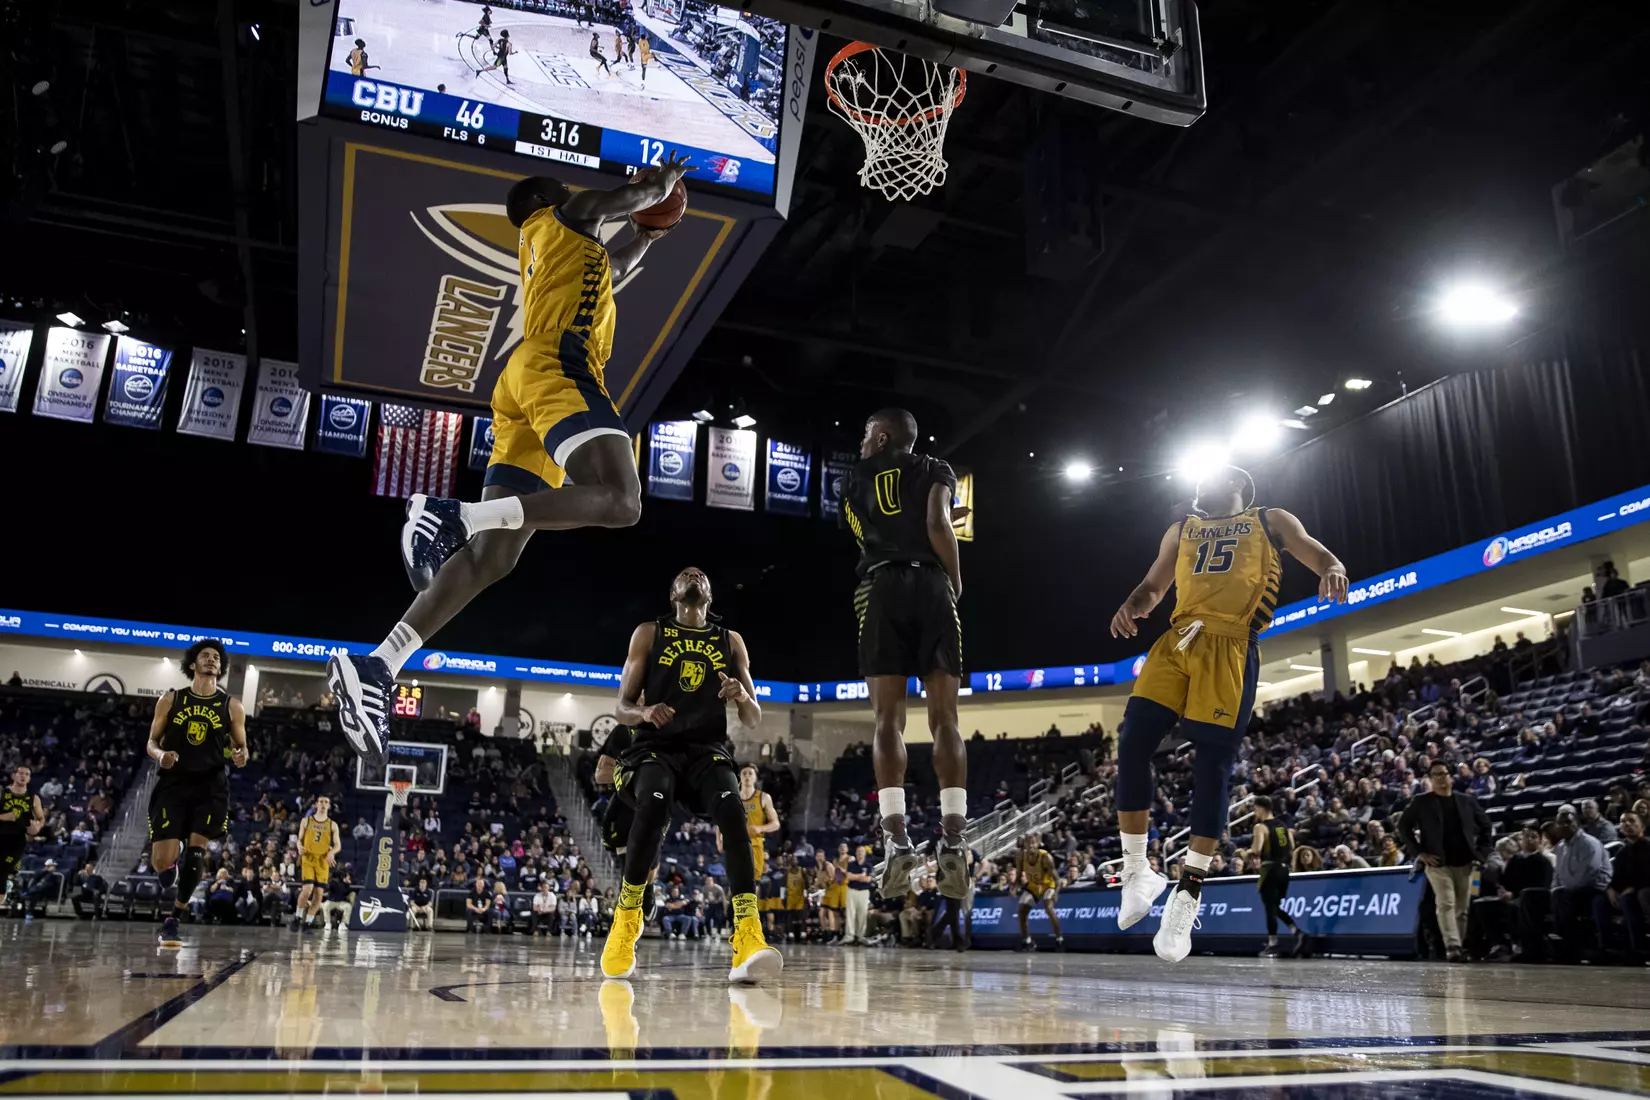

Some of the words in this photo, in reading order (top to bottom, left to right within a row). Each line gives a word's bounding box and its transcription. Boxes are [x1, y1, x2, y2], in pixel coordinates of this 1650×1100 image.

[790, 37, 806, 123] pepsi
[352, 79, 425, 117] CBU
[361, 110, 408, 129] BONUS
[456, 100, 484, 129] 46
[444, 127, 468, 141] FLS
[478, 134, 486, 145] 6
[540, 118, 580, 147] 3:16
[530, 145, 552, 158] 1ST
[559, 150, 590, 165] HALF
[640, 139, 665, 167] 12
[626, 165, 638, 176] FL
[420, 274, 508, 394] LANCERS
[48, 356, 100, 368] BASKETBALL
[129, 356, 156, 366] MEN'S
[203, 356, 234, 370] 2015
[116, 362, 166, 376] BASKETBALL
[204, 368, 228, 377] MEN'S
[192, 375, 240, 388] BASKETBALL
[271, 379, 296, 388] MEN'S
[48, 390, 81, 400] DIVISION
[258, 386, 307, 397] BASKETBALL
[41, 396, 92, 409] TOURNAMENT
[110, 400, 161, 414] TOURNAMENT
[110, 408, 156, 420] CHAMPIONS
[188, 408, 224, 418] DIVISION
[188, 418, 214, 426] SWEET
[260, 418, 291, 428] DIVISION
[253, 425, 302, 436] TOURNAMENT
[317, 430, 364, 442] CHAMPIONS
[649, 475, 691, 486] CHAMPIONS
[875, 468, 902, 516] 0
[1187, 522, 1254, 540] LANCERS
[1508, 522, 1572, 550] MAGNOLIA
[1192, 538, 1239, 576] 15
[1348, 572, 1418, 605] 800-2GET-AIR
[1274, 616, 1286, 626] GO
[1286, 609, 1306, 622] HOME
[1307, 606, 1318, 616] TO
[62, 622, 108, 634] COMFORT
[110, 627, 130, 636] YOU
[132, 629, 160, 639] WANT
[163, 632, 175, 640] TO
[177, 634, 190, 642] GO
[221, 638, 234, 646] TO
[664, 627, 679, 638] 55
[272, 640, 348, 656] 800-2GET-AIR
[658, 639, 726, 671] BETHESDA
[530, 667, 570, 676] COMFORT
[571, 670, 588, 678] YOU
[588, 672, 614, 680] WANT
[21, 679, 78, 689] ADEMICALLY
[986, 673, 1002, 691] 12
[138, 688, 164, 696] BIBLIC
[399, 686, 422, 699] 3:16
[836, 682, 870, 700] CBU
[183, 696, 188, 705] 1
[395, 696, 417, 716] 28
[172, 705, 223, 730] BETHESDA
[314, 830, 322, 842] 3
[375, 836, 394, 889] CBU
[1028, 908, 1073, 920] COMORT
[1074, 907, 1096, 918] YOU
[1096, 906, 1120, 918] WAN
[1210, 902, 1228, 916] TO
